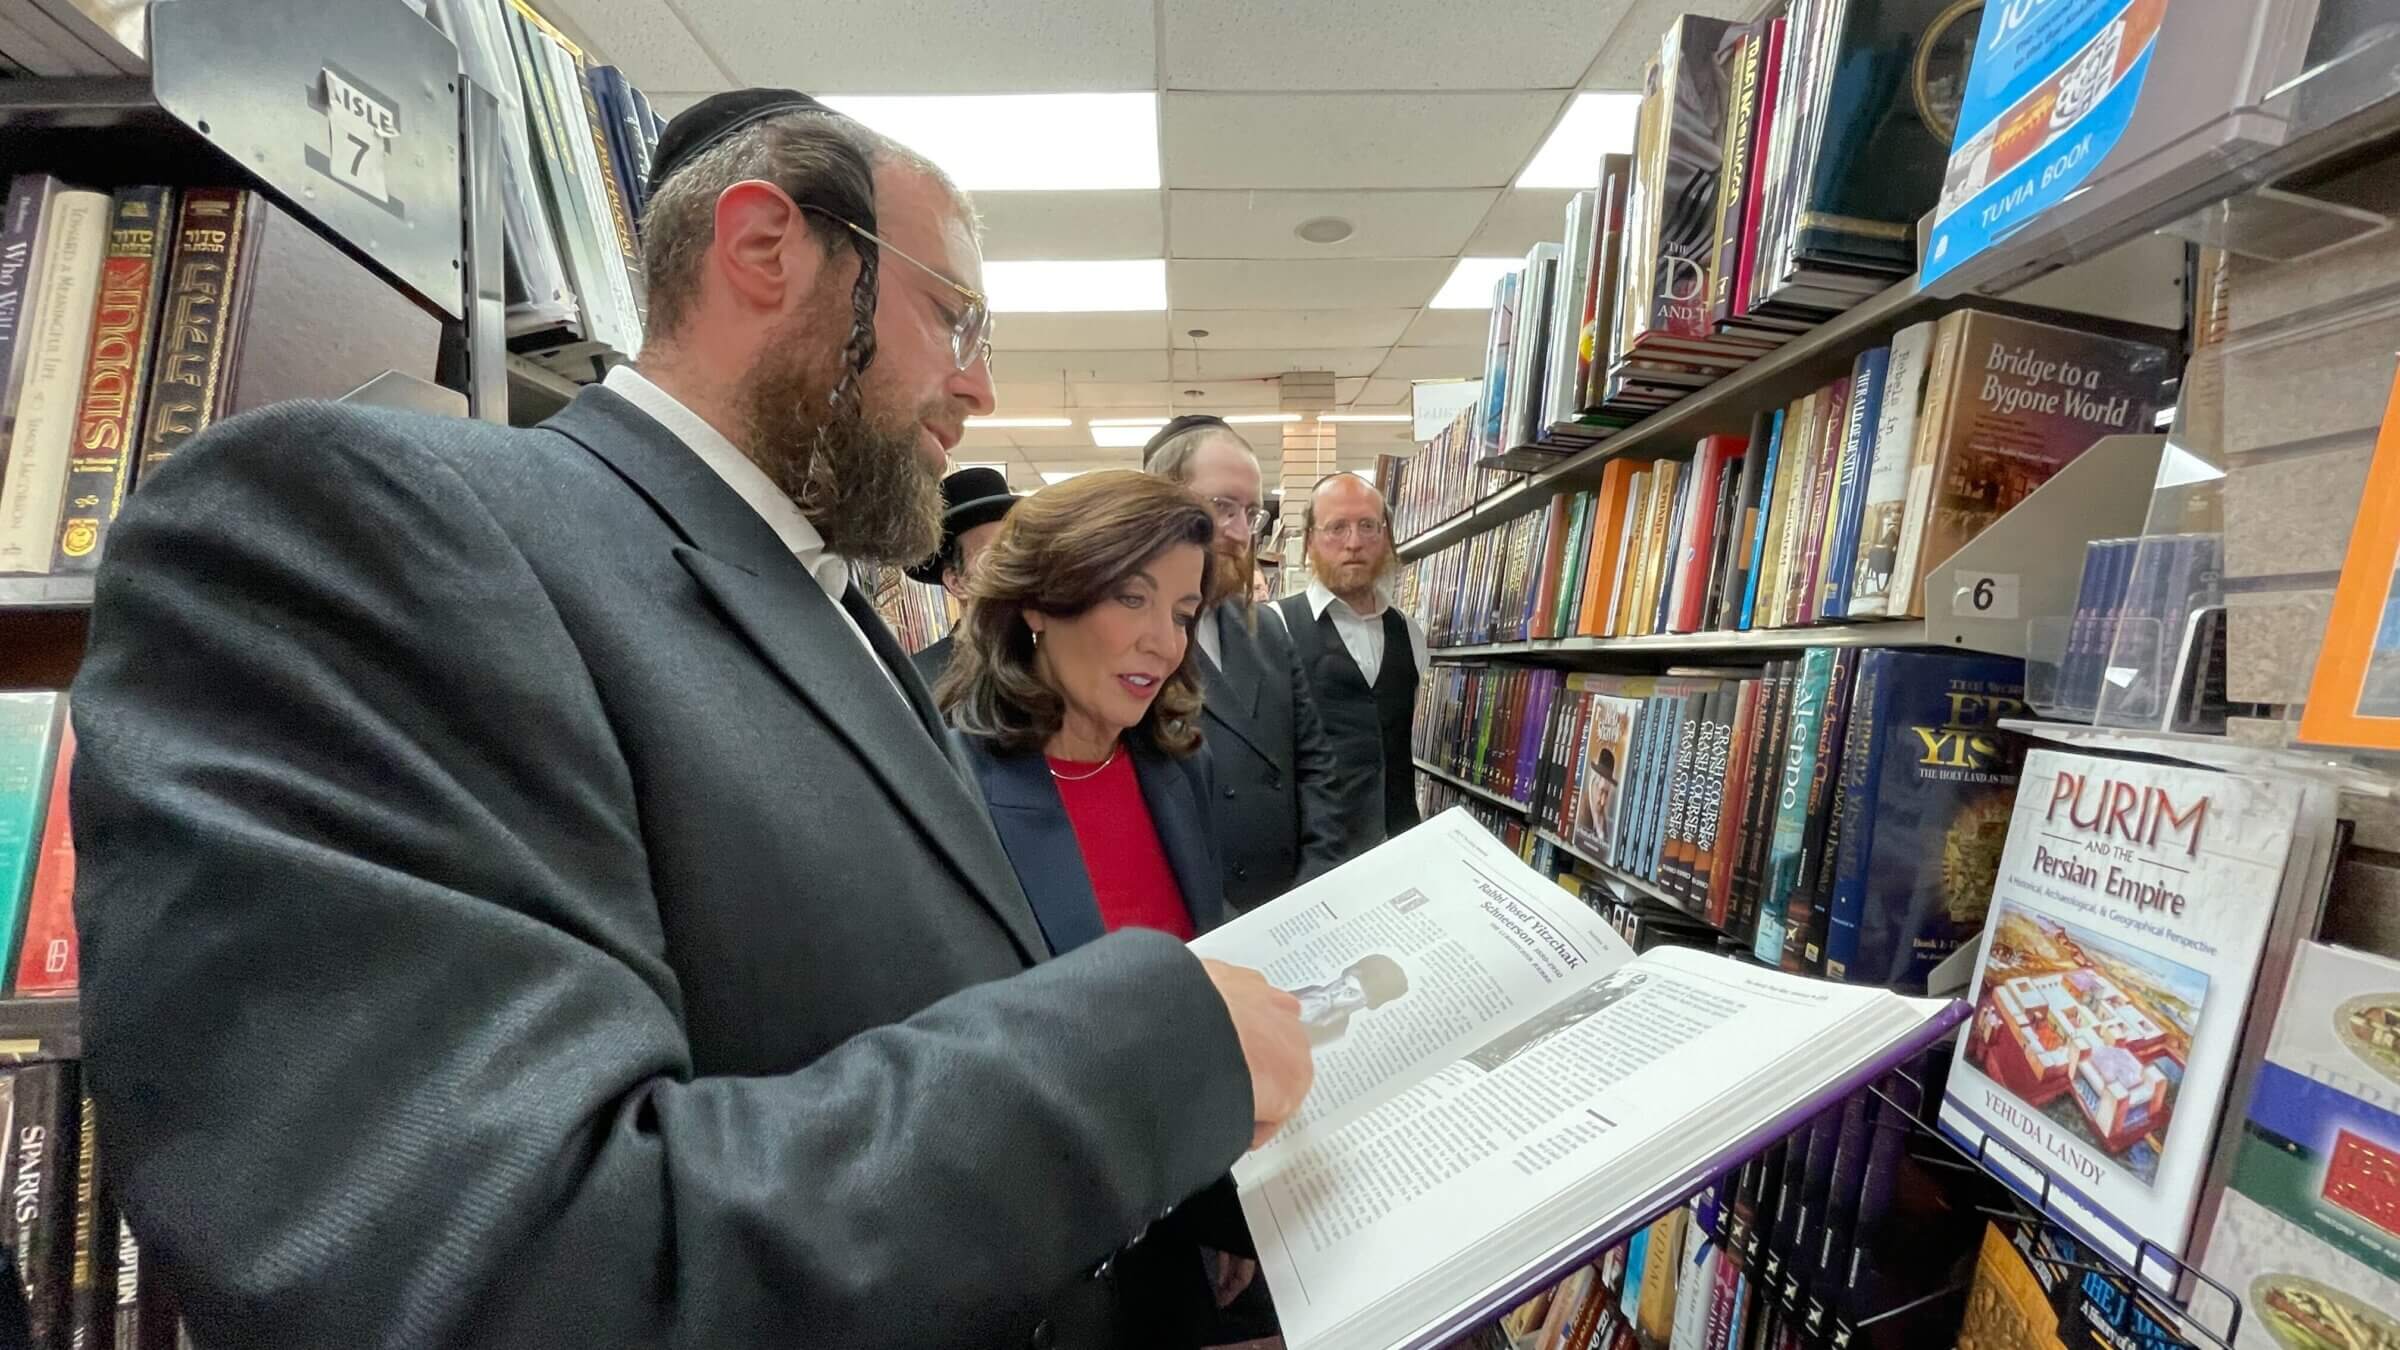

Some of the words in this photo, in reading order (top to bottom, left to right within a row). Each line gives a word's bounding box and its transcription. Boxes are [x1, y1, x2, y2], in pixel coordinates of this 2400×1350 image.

[346, 132, 370, 177] 7
[1982, 180, 2034, 229] TUVIA
[2040, 133, 2093, 189] BOOK
[184, 229, 226, 244] סדור
[2, 242, 28, 285] Who
[1657, 304, 1693, 320] AND
[82, 264, 148, 451] SIDDUR
[1986, 343, 2057, 386] Bridge
[2060, 357, 2083, 386] to
[2085, 368, 2101, 390] a
[1852, 368, 1871, 424] HERALD
[1979, 373, 2059, 414] Bygone
[2062, 389, 2129, 427] World
[1973, 578, 1995, 611] 6
[1680, 720, 1697, 771] CRASH
[1698, 720, 1715, 772] CRASH
[1717, 724, 1732, 777] CRASH
[1919, 767, 1938, 780] THE
[1939, 769, 1963, 781] HOLY
[1673, 774, 1689, 829] COURSE
[1688, 775, 1704, 833] COURSE
[1707, 779, 1723, 840] COURSE
[2046, 770, 2209, 858] PURIM
[2083, 840, 2111, 857] AND
[2112, 844, 2135, 864] THE
[2033, 845, 2098, 890] Persian
[2105, 864, 2186, 917] Empire
[1479, 900, 1536, 947] Schneerson
[1479, 881, 1507, 905] Rabbi
[1505, 901, 1535, 925] Yosef
[1530, 920, 1580, 971] Yitzchak
[2109, 908, 2165, 938] Geographical
[2165, 925, 2219, 957] Perspective
[1984, 1089, 2042, 1139] YEHUDA
[2046, 1133, 2108, 1187] LANDY
[14, 1125, 47, 1223] SPARKS
